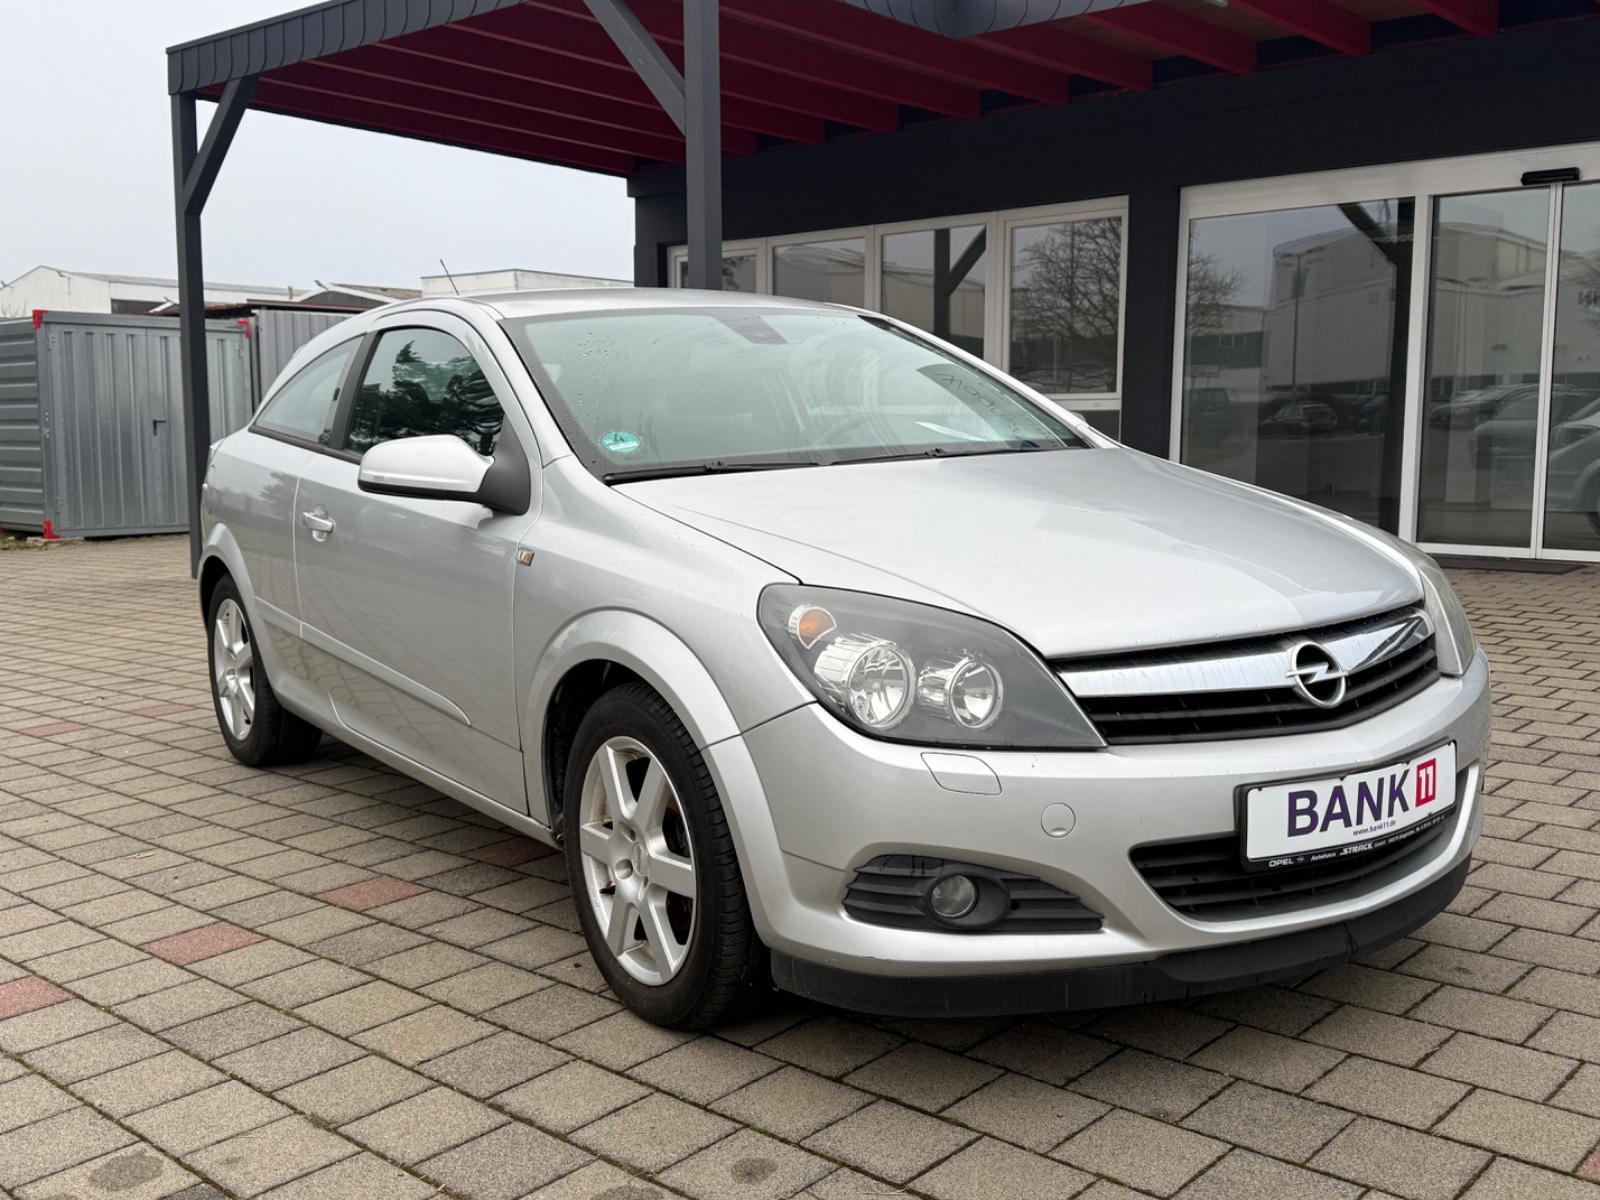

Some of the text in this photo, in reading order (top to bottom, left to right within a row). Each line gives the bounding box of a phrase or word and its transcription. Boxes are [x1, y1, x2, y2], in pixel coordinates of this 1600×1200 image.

[1287, 769, 1410, 838] BANK
[1418, 763, 1435, 803] 11
[1353, 820, 1396, 836] www.bank11.de
[1268, 858, 1294, 868] OPEL
[1341, 844, 1373, 856] STRACK
